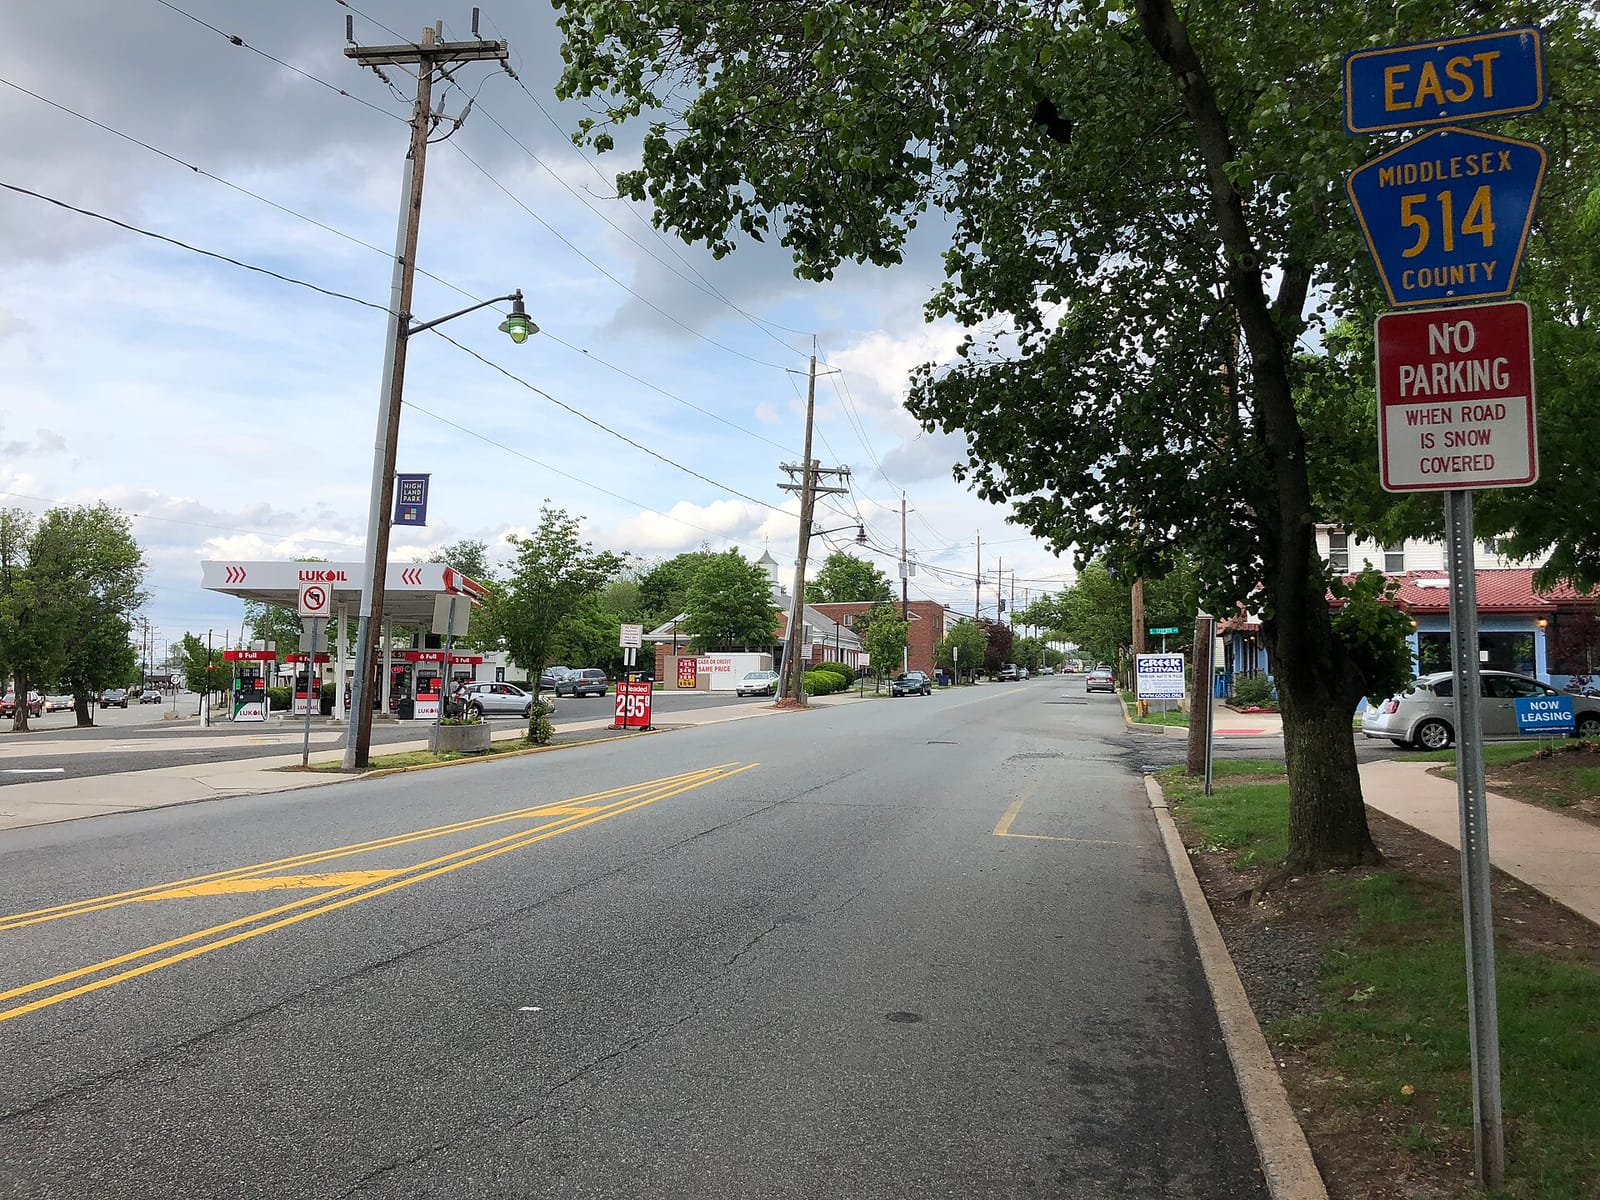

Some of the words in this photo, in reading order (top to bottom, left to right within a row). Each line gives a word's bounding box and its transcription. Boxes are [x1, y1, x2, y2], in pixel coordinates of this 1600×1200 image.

[1384, 51, 1501, 112] EAST
[1379, 150, 1513, 188] MIDDLESEX
[1400, 185, 1497, 258] 514
[1402, 260, 1497, 290] COUNTY
[1428, 320, 1476, 355] NO
[1399, 357, 1510, 397] PARKING
[1405, 407, 1452, 426] WHEN
[1461, 403, 1506, 422] ROAD
[1420, 432, 1435, 449] IS
[1444, 429, 1491, 448] SNOW
[1420, 454, 1495, 474] COVERED
[298, 569, 347, 581] LUKOIL
[1139, 659, 1180, 667] GREEK
[1521, 711, 1571, 722] LEASING
[1530, 701, 1559, 710] NOW
